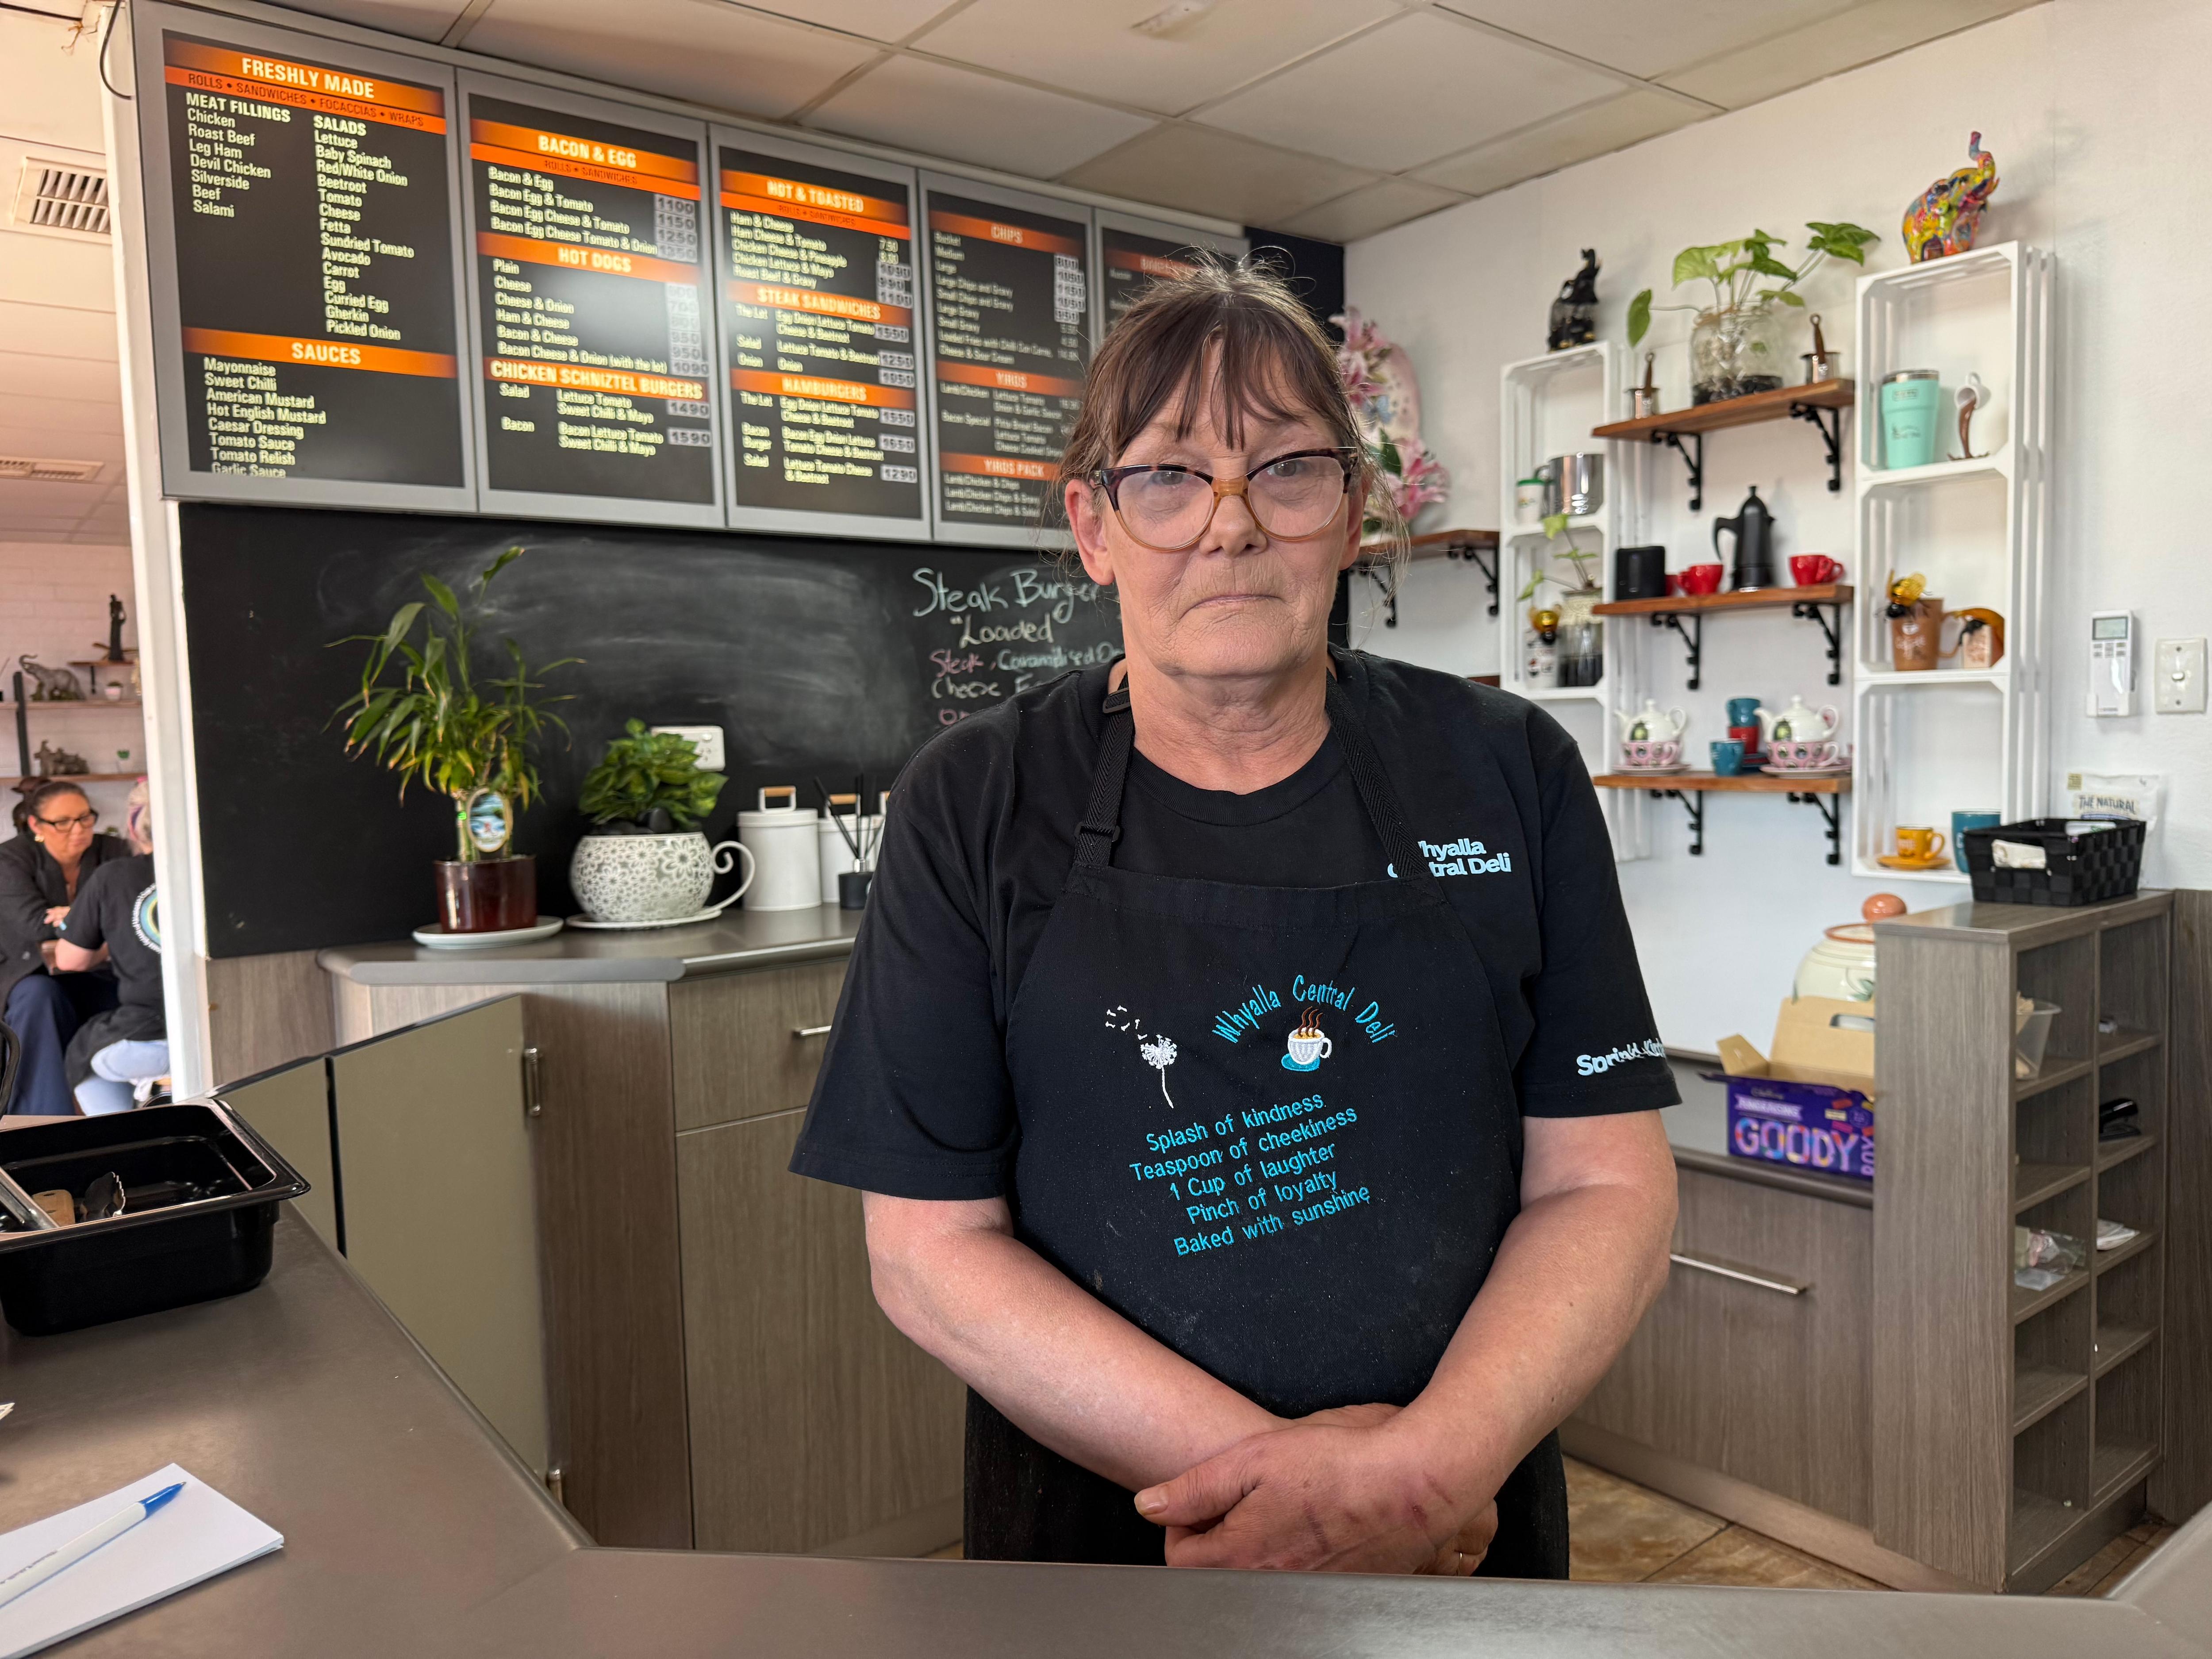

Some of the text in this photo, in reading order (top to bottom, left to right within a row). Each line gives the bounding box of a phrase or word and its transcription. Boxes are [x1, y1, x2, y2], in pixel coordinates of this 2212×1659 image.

[242, 58, 374, 99] FRESHLY MADE
[186, 92, 291, 123] MEAT FILLINGS
[188, 73, 424, 127] ROLLS SANDWICHES FOCACCIAS WRAPS
[187, 109, 236, 128] Chicken
[313, 115, 366, 136] SALADS
[188, 124, 256, 146] Roast Beef
[315, 130, 358, 148] Lettuce
[189, 139, 242, 159] Leg Ham
[315, 145, 392, 170] Baby Spinach
[538, 134, 637, 168] BACON & EGG
[190, 154, 272, 178] Devil Chicken
[316, 159, 408, 187] Red/White Onion
[544, 159, 637, 185] ROLLS SANDWICHES
[191, 169, 250, 190] Silverside
[317, 174, 367, 193] Beetroot
[488, 166, 554, 192] Bacon & Egg
[192, 185, 222, 200] Beef
[318, 189, 362, 207] Tomato
[489, 183, 593, 213] Bacon Egg & Tomato
[767, 180, 864, 213] HOT & TOASTED
[193, 200, 235, 217] Salami
[319, 203, 361, 221] Cheese
[490, 200, 630, 234] Bacon Egg Cheese & Tomato
[320, 218, 351, 234] Fetta
[491, 216, 658, 255] Bacon Egg Cheese Tomato & Onion
[991, 224, 1023, 244] CHIPS
[320, 232, 415, 258] Sundried Tomato
[322, 247, 371, 266] Avocado
[493, 258, 519, 275] Plain
[558, 247, 631, 273] HOT DOGS
[322, 262, 360, 278] Carrot
[323, 276, 346, 293] Egg
[494, 275, 531, 292] Cheese
[324, 291, 389, 313] Curried Egg
[495, 292, 574, 314] Cheese & Onion
[757, 288, 880, 320] STEAK SANDWICHES
[326, 305, 369, 322] Gherkin
[495, 308, 569, 330] Ham & Cheese
[326, 319, 401, 341] Pickled Onion
[496, 324, 579, 346] Bacon & Cheese
[291, 342, 361, 365] SAUCES
[497, 341, 530, 357] Bacon
[531, 345, 568, 361] Cheese
[568, 349, 579, 363] &
[580, 349, 608, 366] Onion
[634, 357, 650, 371] the
[204, 357, 276, 376] Mayonnaise
[204, 373, 277, 391] Sweet Chilli
[491, 360, 703, 400] CHICKEN SCHNIZTEL BURGERS
[499, 383, 530, 399] Salad
[782, 377, 866, 402] HAMBURGERS
[206, 388, 315, 409] American Mustard
[671, 402, 708, 415] 1490
[206, 403, 326, 424] Hot English Mustard
[501, 417, 535, 432] Bacon
[208, 417, 304, 440] Caesar Dressing
[672, 431, 710, 444] 1590
[209, 433, 296, 451] Tomato Sauce
[210, 447, 296, 465] Tomato Relish
[211, 462, 286, 479] Garlic Sauce
[912, 568, 1008, 617] Steak
[2079, 796, 2135, 815] THE NATURAL
[1417, 838, 1486, 861] hyalla
[1467, 853, 1511, 874] Deli
[1212, 975, 1398, 1043] Whyalla Central Deli
[1146, 1094, 1324, 1152] Splash of kindness
[1129, 1108, 1358, 1182] Teaspoon of cheekiness
[1735, 1118, 1859, 1171] GOODY
[1170, 1144, 1335, 1201] 1 Cup of laughter
[1186, 1171, 1337, 1225] Pinch of loyalty
[1174, 1184, 1371, 1256] Baked with sunshine
